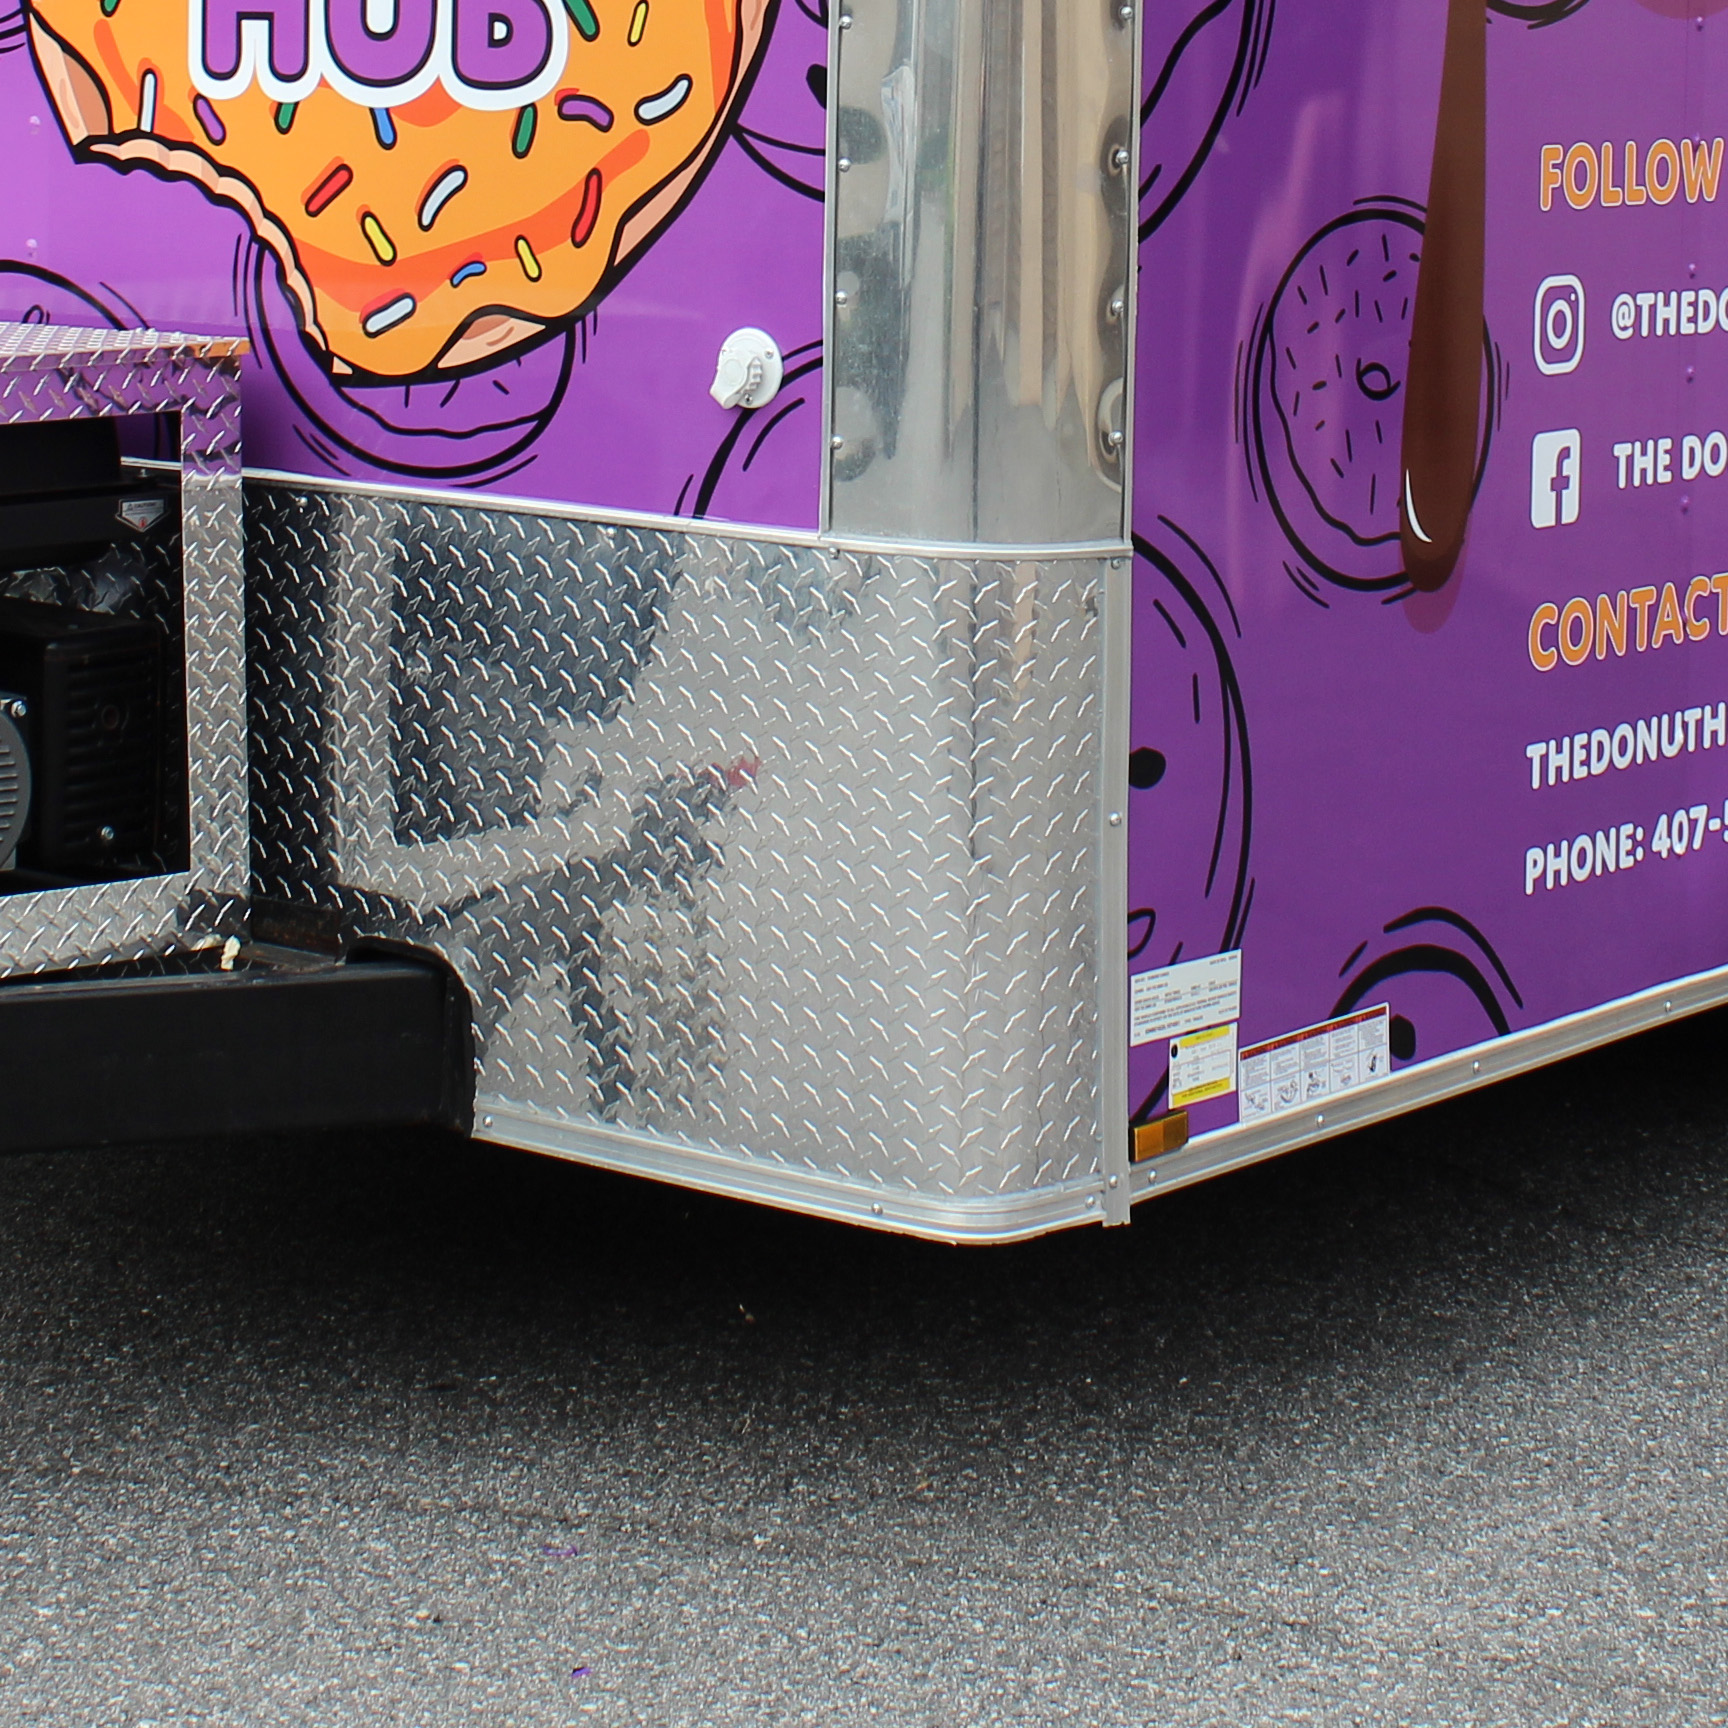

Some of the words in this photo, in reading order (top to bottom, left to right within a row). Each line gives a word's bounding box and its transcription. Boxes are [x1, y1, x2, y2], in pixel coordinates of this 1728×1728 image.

[1539, 137, 1724, 213] FOLLOW
[1614, 436, 1673, 490] THE
[1524, 822, 1644, 896] PHONE:
